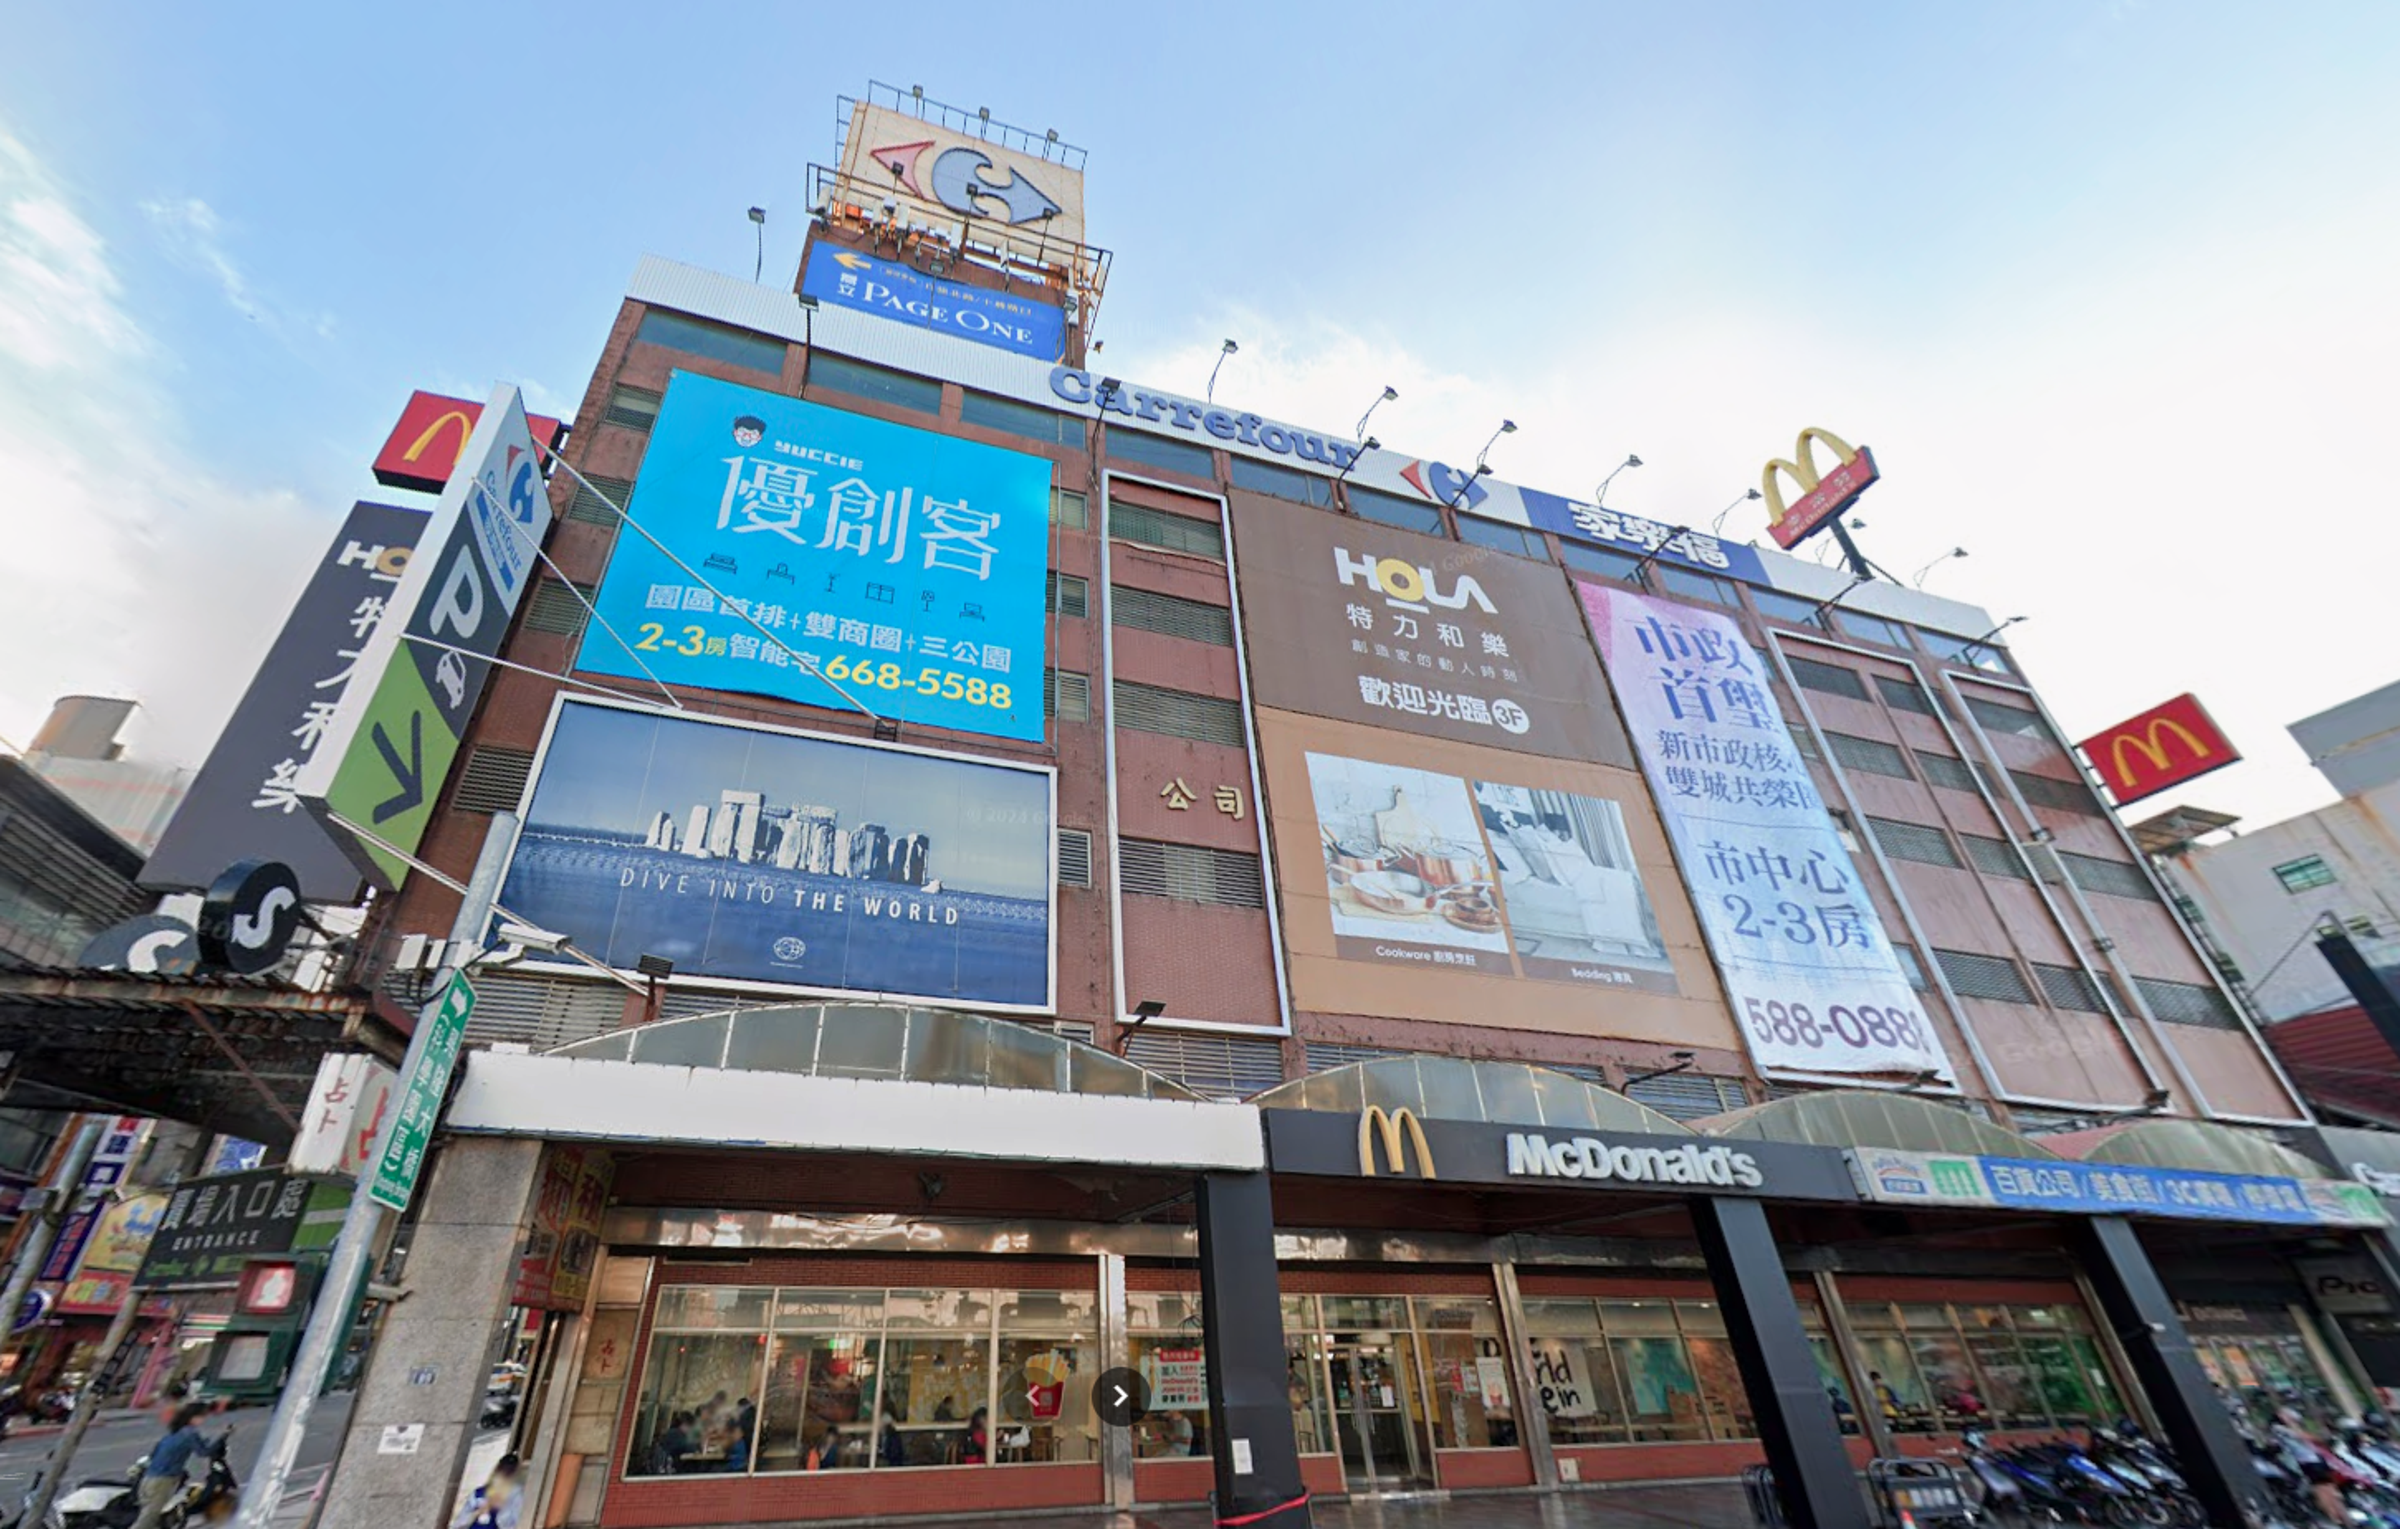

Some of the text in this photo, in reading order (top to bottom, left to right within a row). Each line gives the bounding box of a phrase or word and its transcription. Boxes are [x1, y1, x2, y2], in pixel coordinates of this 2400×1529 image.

[1050, 366, 1356, 471] Carrefour
[774, 441, 864, 471] YUCCIE
[715, 455, 1000, 581] 優創客
[1567, 502, 1731, 569] 家樂福
[430, 544, 484, 639] P
[1333, 546, 1499, 614] HOLA
[1346, 603, 1510, 658] 特力和樂
[1626, 614, 1754, 676] 市政
[824, 654, 1012, 710] 668-5588
[1358, 674, 1494, 726] 歡迎光臨
[1159, 776, 1245, 821] 公司
[1697, 839, 1851, 896] 市中心
[619, 867, 959, 926] DIVE INTO THE WORLD
[1721, 893, 1871, 950] 2-3房
[1374, 945, 1432, 962] Cookware
[1506, 1132, 1764, 1189] McDonald's
